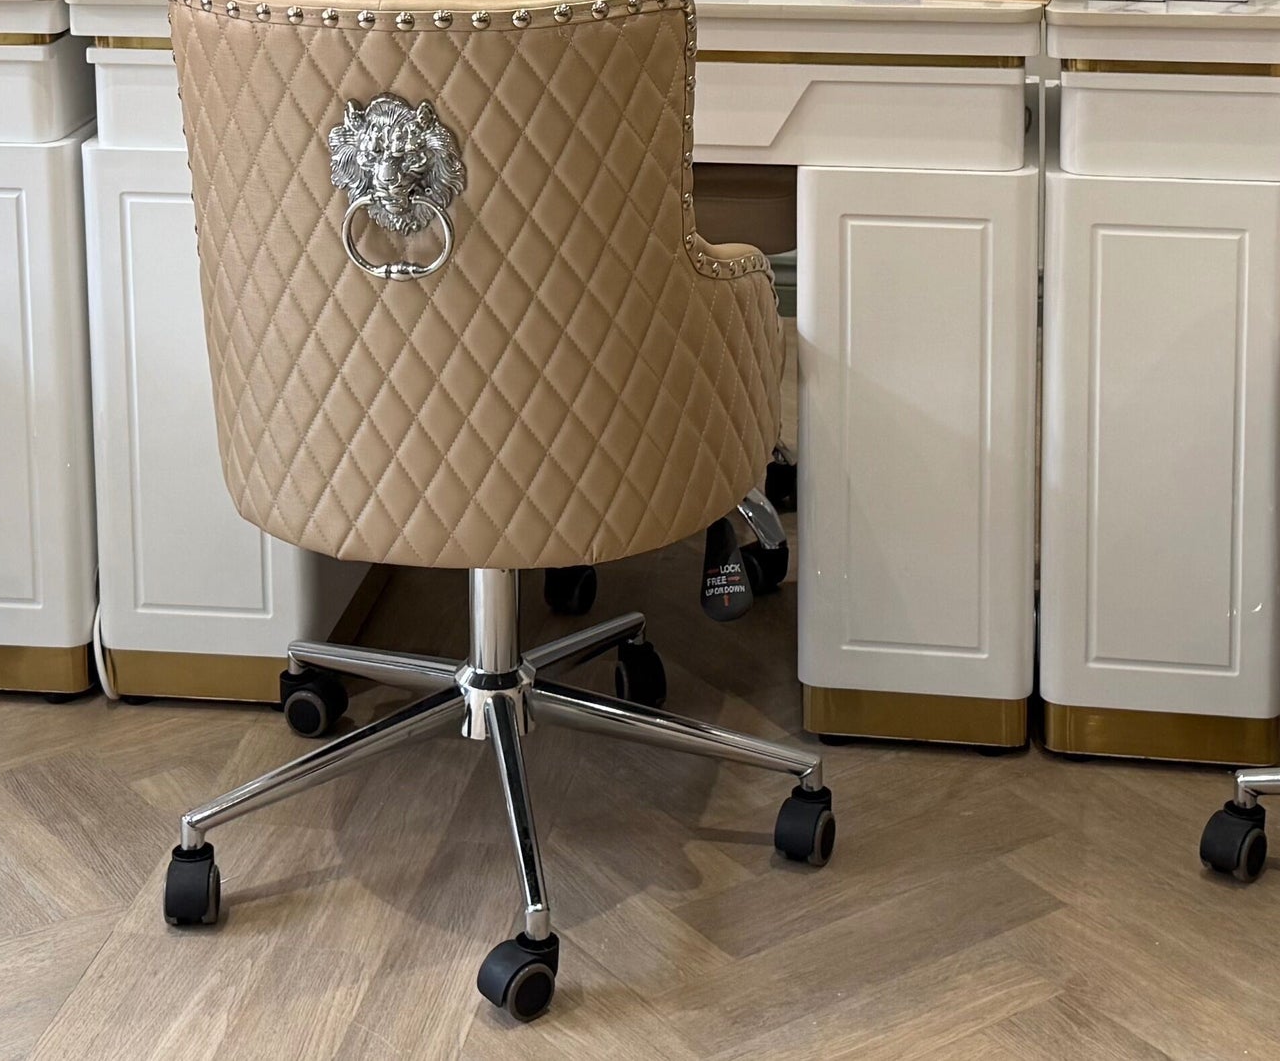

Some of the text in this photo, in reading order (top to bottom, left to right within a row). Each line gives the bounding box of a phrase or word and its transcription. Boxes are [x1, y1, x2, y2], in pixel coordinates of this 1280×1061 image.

[720, 563, 741, 574] LOCK
[706, 575, 727, 587] FREE
[705, 588, 714, 597] UP
[724, 585, 746, 594] DOWN
